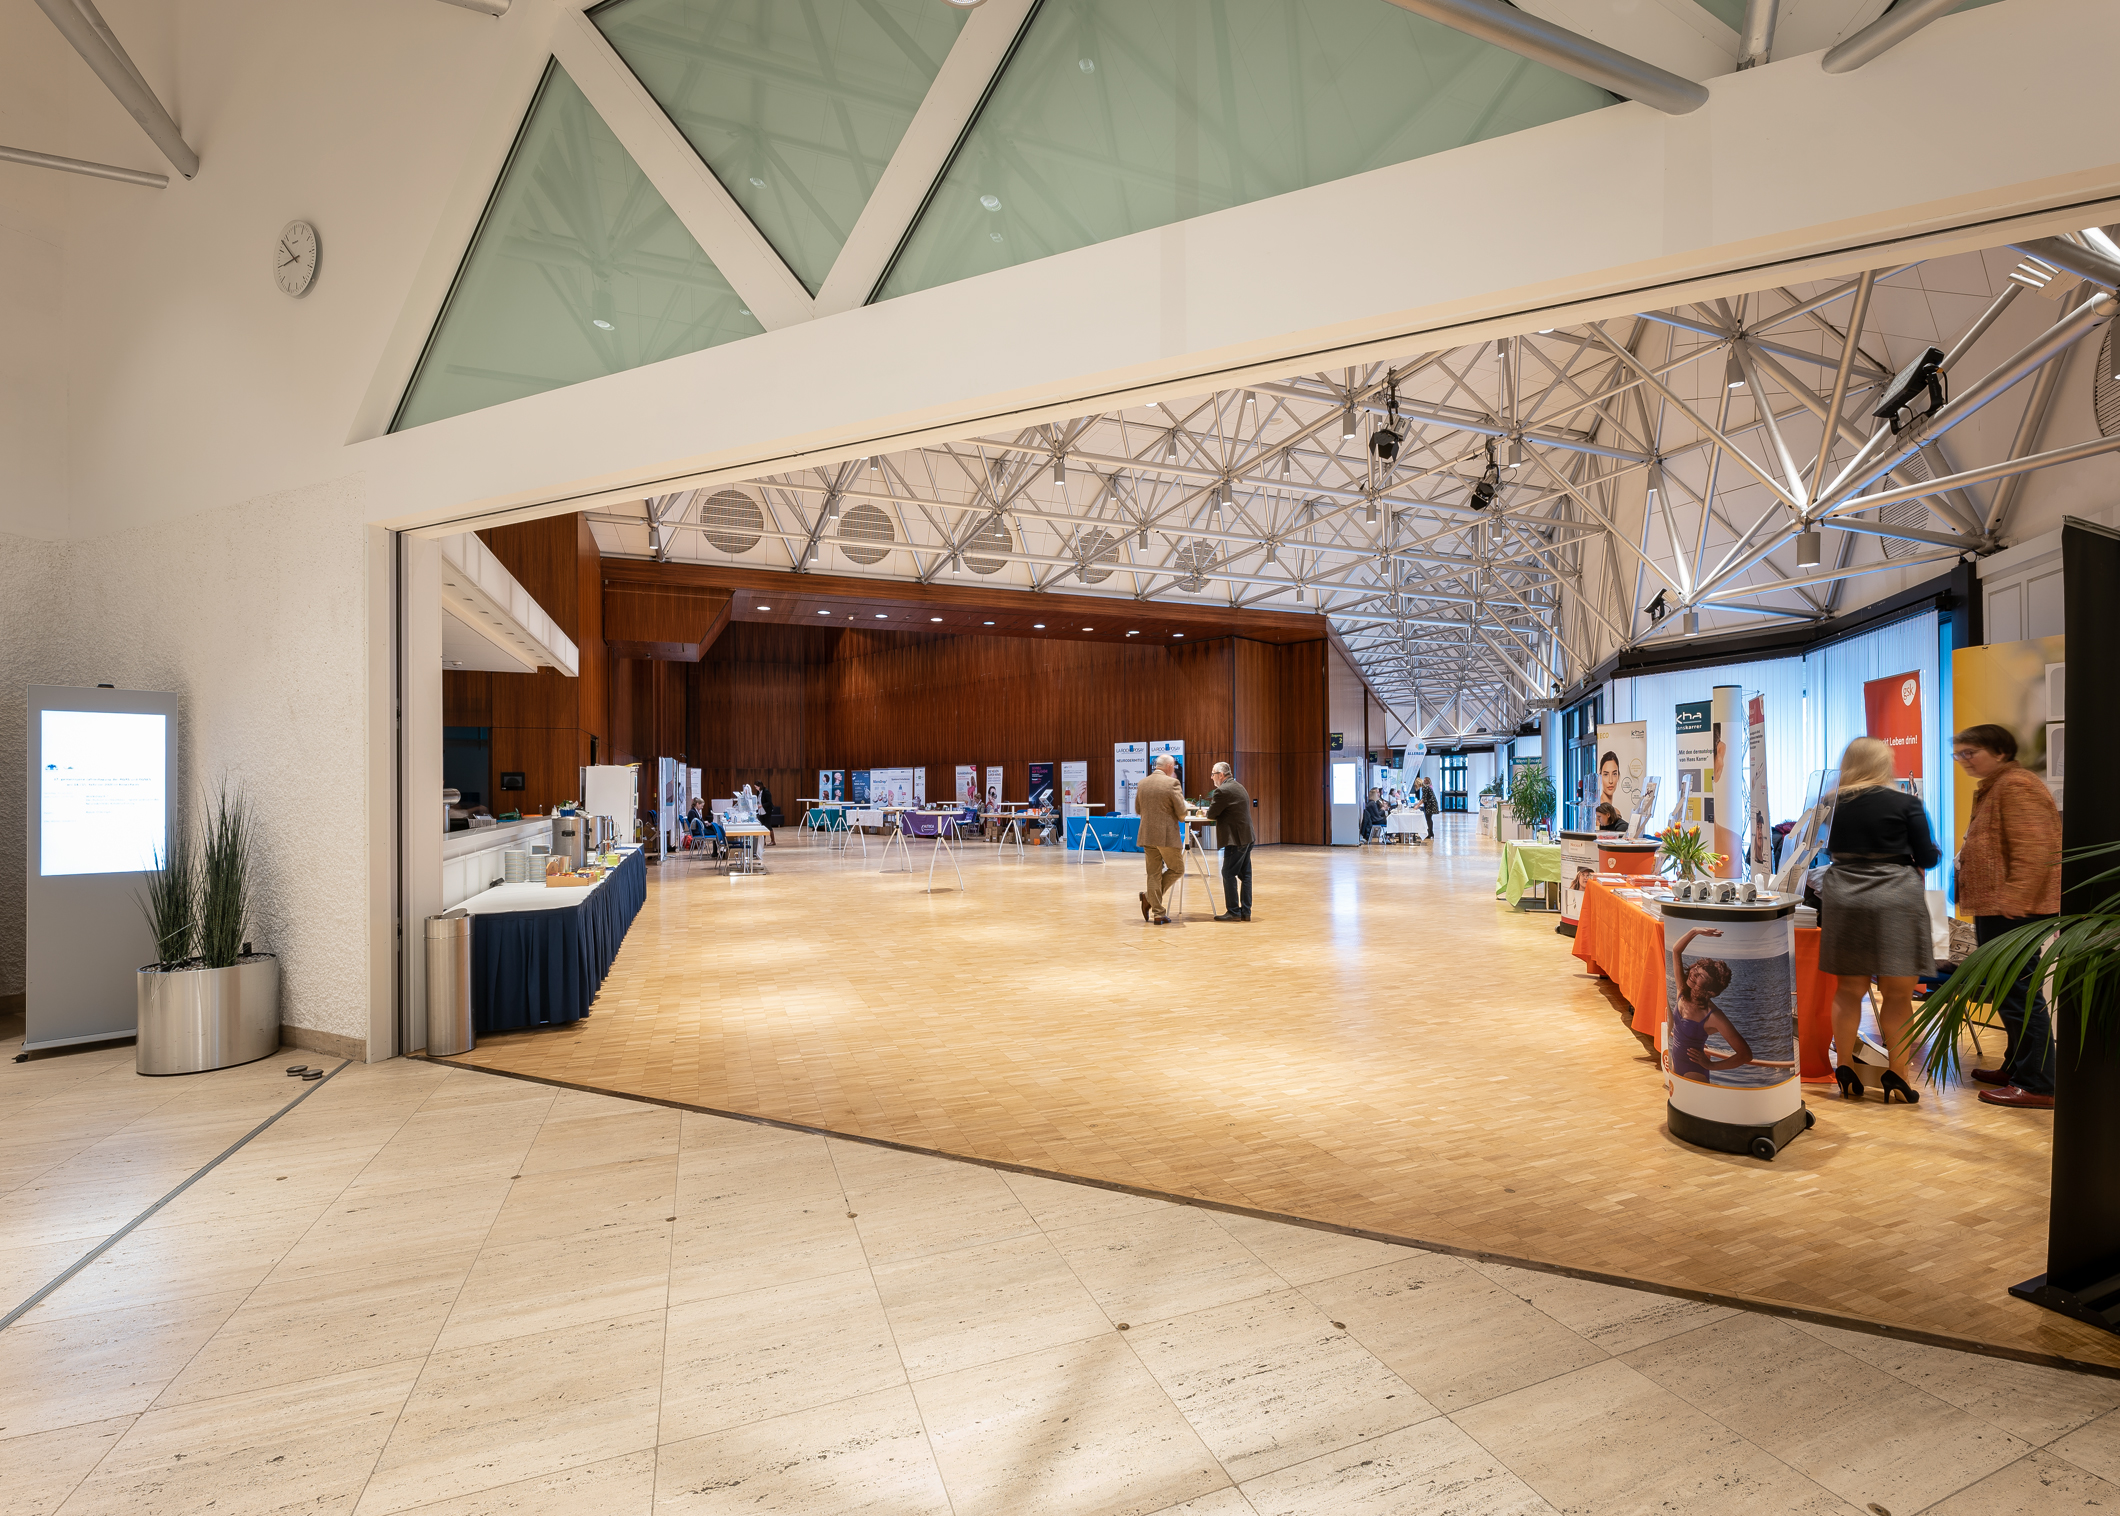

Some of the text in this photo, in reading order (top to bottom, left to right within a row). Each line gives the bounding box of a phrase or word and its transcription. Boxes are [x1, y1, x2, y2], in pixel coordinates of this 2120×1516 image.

[1903, 684, 1914, 700] gsk
[1889, 737, 1904, 746] Leben
[1906, 735, 1917, 745] drin!
